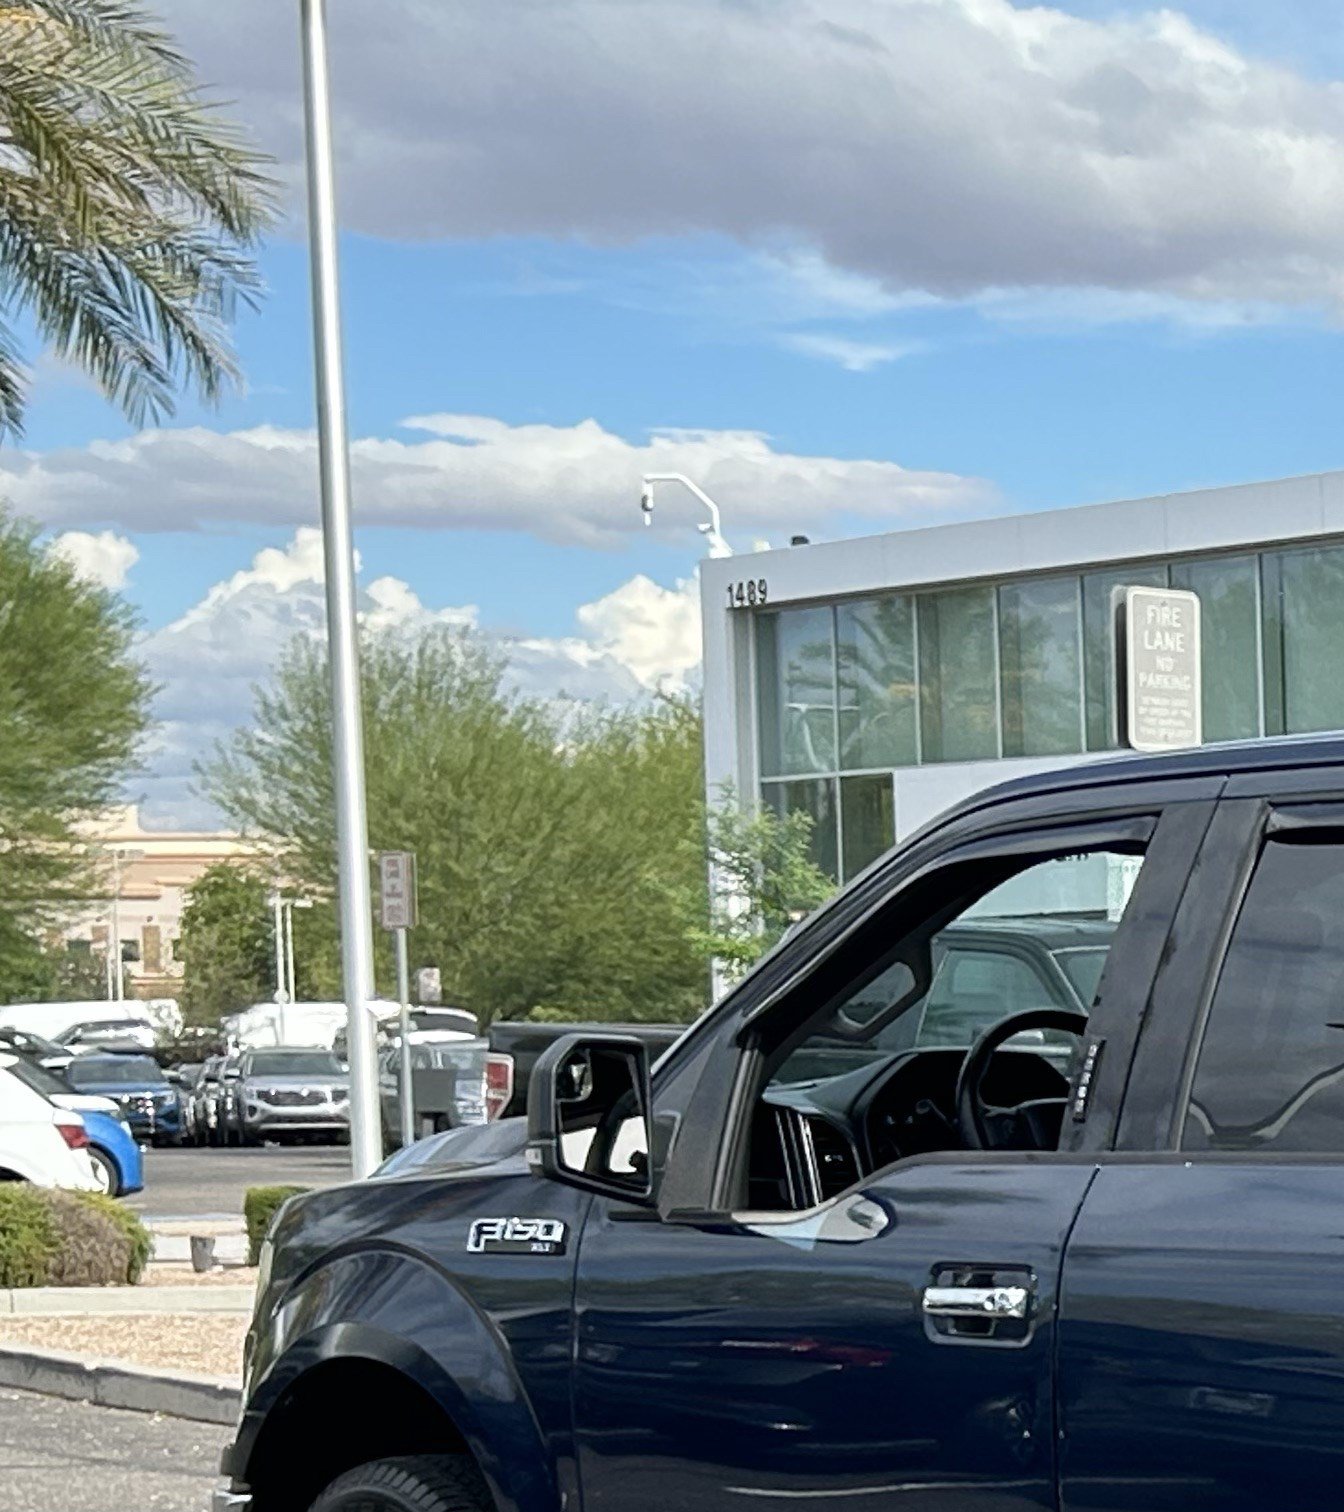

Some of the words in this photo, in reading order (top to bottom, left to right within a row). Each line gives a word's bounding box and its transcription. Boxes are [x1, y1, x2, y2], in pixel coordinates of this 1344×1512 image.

[727, 578, 768, 607] 1489
[1146, 604, 1182, 628] FIRE
[1143, 629, 1185, 653] LANE
[1138, 671, 1192, 691] PARKING
